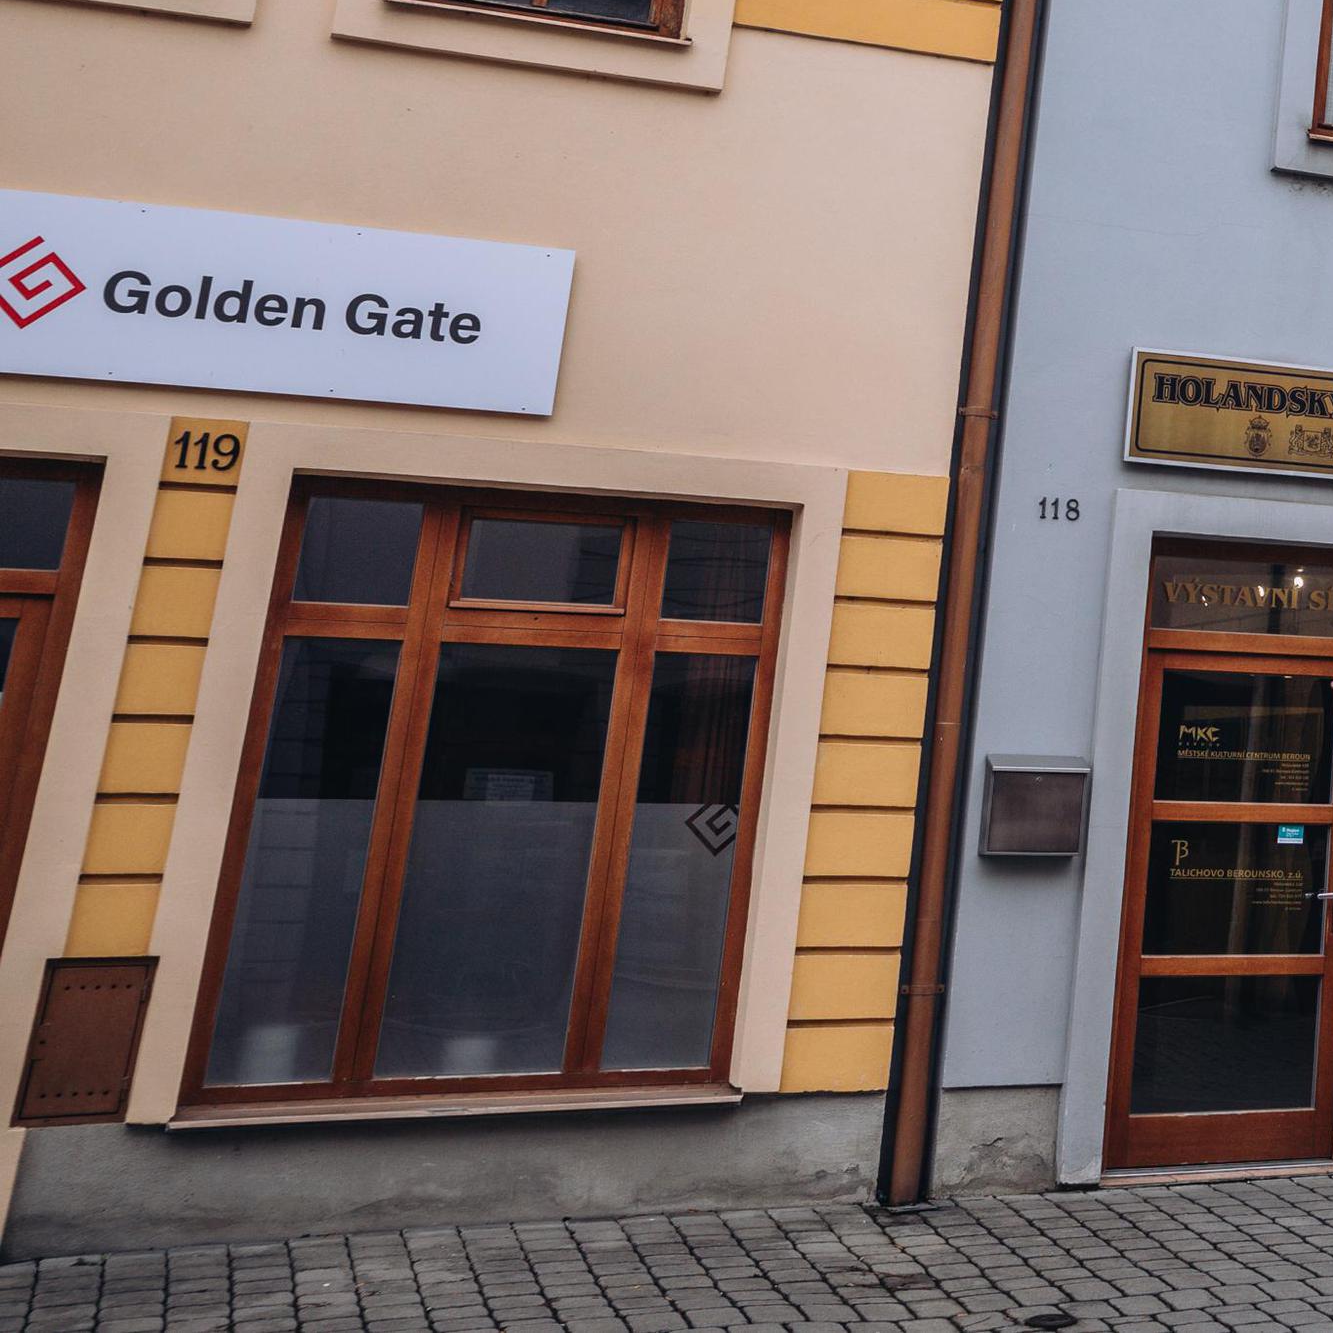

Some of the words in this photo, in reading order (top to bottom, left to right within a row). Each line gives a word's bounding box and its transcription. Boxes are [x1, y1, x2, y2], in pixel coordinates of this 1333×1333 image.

[103, 270, 326, 331] Golden
[345, 293, 481, 345] Gate
[174, 430, 240, 471] 119
[1039, 497, 1080, 521] 118
[1163, 577, 1300, 610] VÝSTAVNÍ
[1178, 725, 1221, 742] MKC
[1210, 749, 1244, 759] KULTURNÍ
[1246, 751, 1280, 760] CENTRUM
[1282, 752, 1311, 761] BEROUN
[1170, 868, 1224, 878] TALICHOVO
[1226, 869, 1285, 880] BEROUNSKO,
